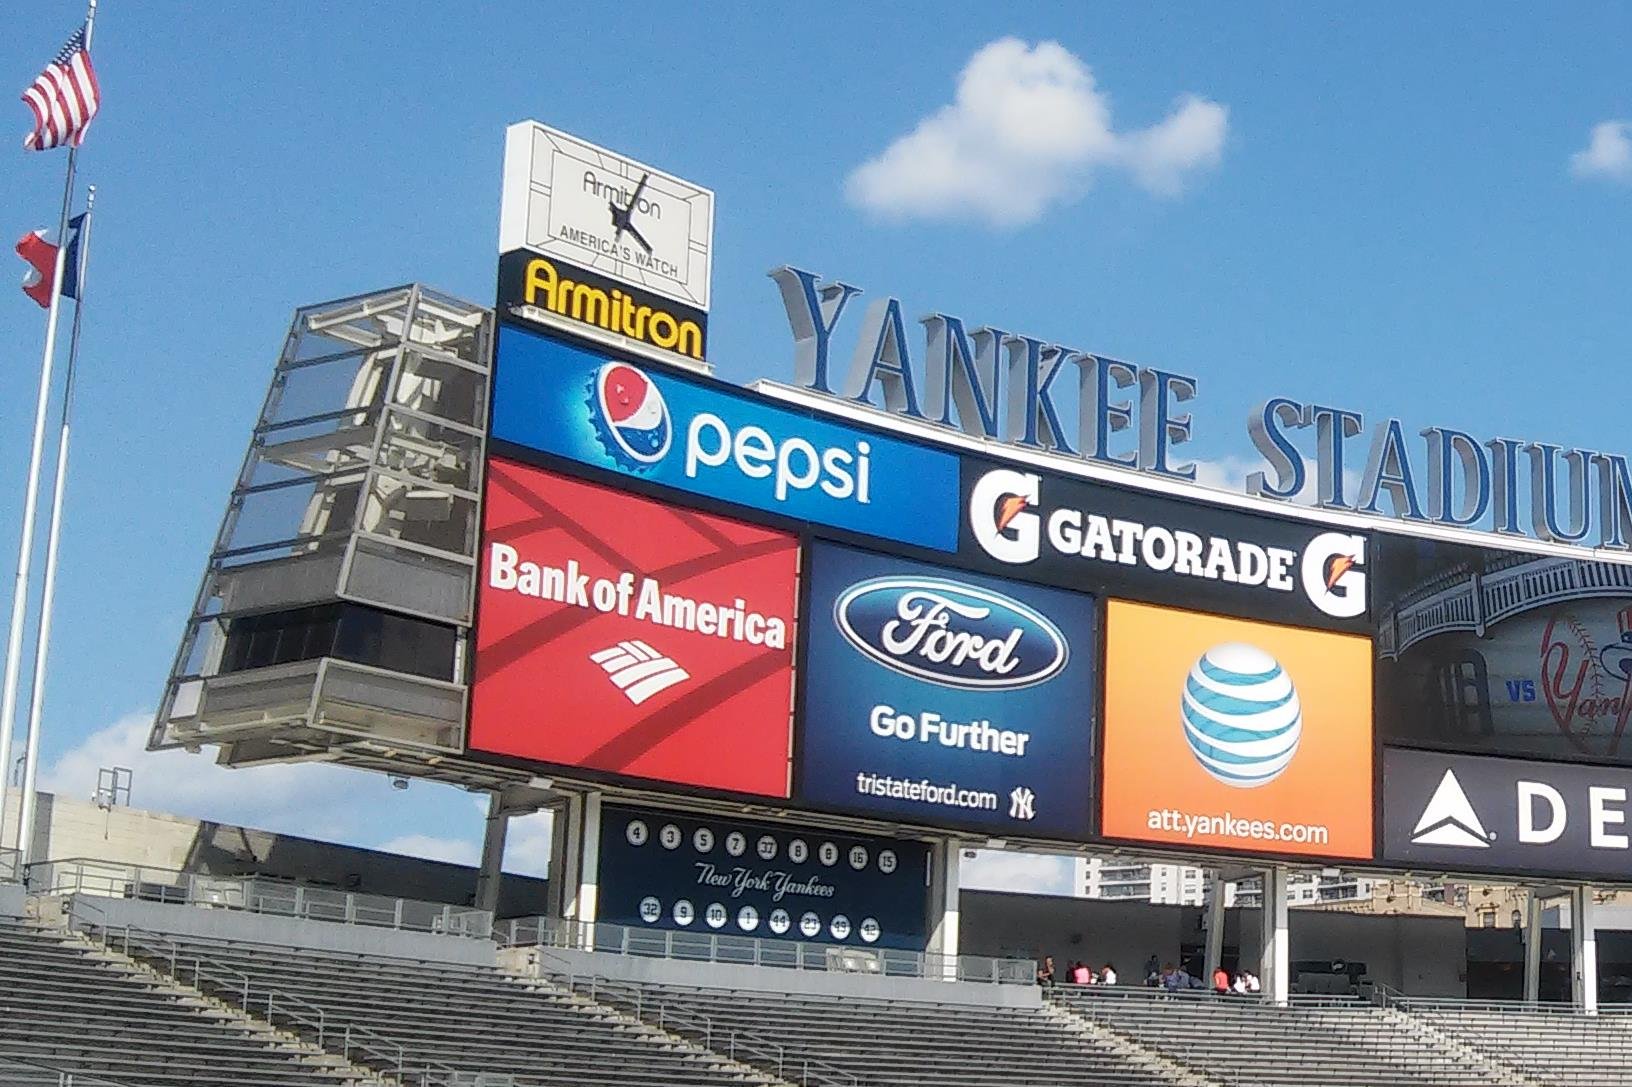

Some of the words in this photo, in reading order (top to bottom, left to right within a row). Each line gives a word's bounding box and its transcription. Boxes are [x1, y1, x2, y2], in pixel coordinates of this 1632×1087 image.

[583, 171, 661, 219] Armiton
[560, 225, 631, 261] AMERICA'S
[635, 251, 678, 277] WATCH
[524, 257, 702, 359] Armitron
[768, 264, 1198, 481] YANKEE
[686, 412, 871, 504] pepsi
[1047, 508, 1295, 591] GATORADE
[488, 542, 589, 607] Bank
[593, 571, 635, 619] of
[635, 579, 786, 650] America
[882, 591, 1024, 674] Ford
[870, 705, 915, 739] Go
[920, 711, 1030, 757] Further
[856, 772, 998, 810] tristateford.com
[1147, 808, 1329, 845] att.yankees.com
[695, 862, 732, 886] New
[731, 867, 774, 897] York
[772, 871, 835, 902] Yankees
